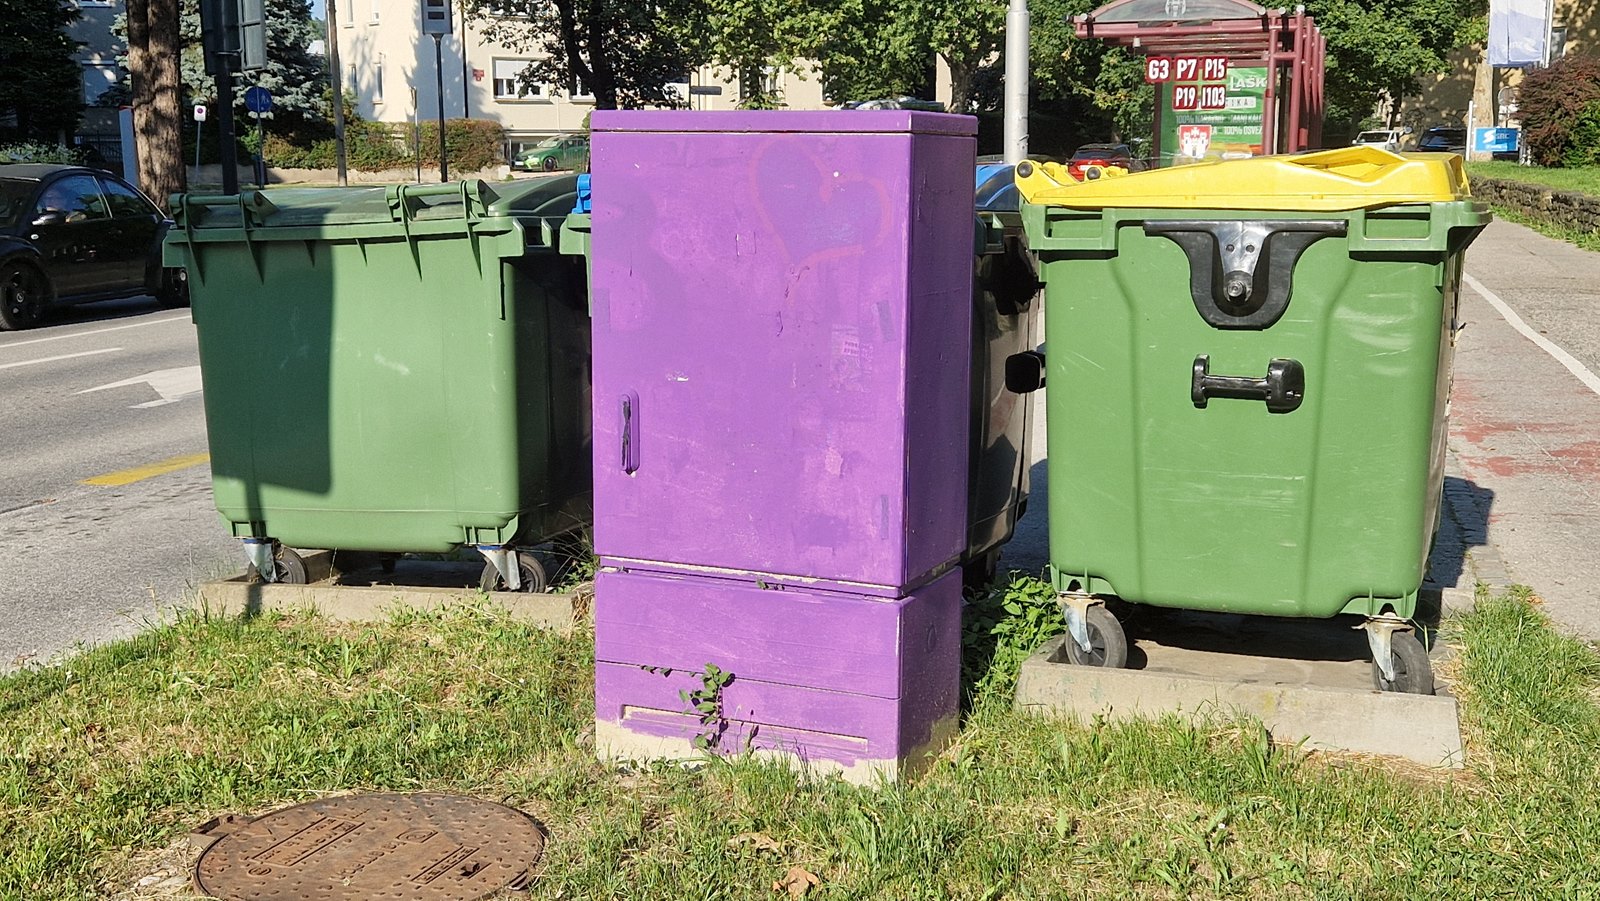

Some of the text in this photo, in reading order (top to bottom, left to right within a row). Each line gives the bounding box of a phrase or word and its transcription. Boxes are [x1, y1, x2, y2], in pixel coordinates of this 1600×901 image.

[1148, 59, 1169, 79] G3
[1176, 59, 1197, 79] P7
[1204, 58, 1225, 79] P15
[1175, 87, 1196, 107] P19
[1225, 126, 1243, 135] 100%
